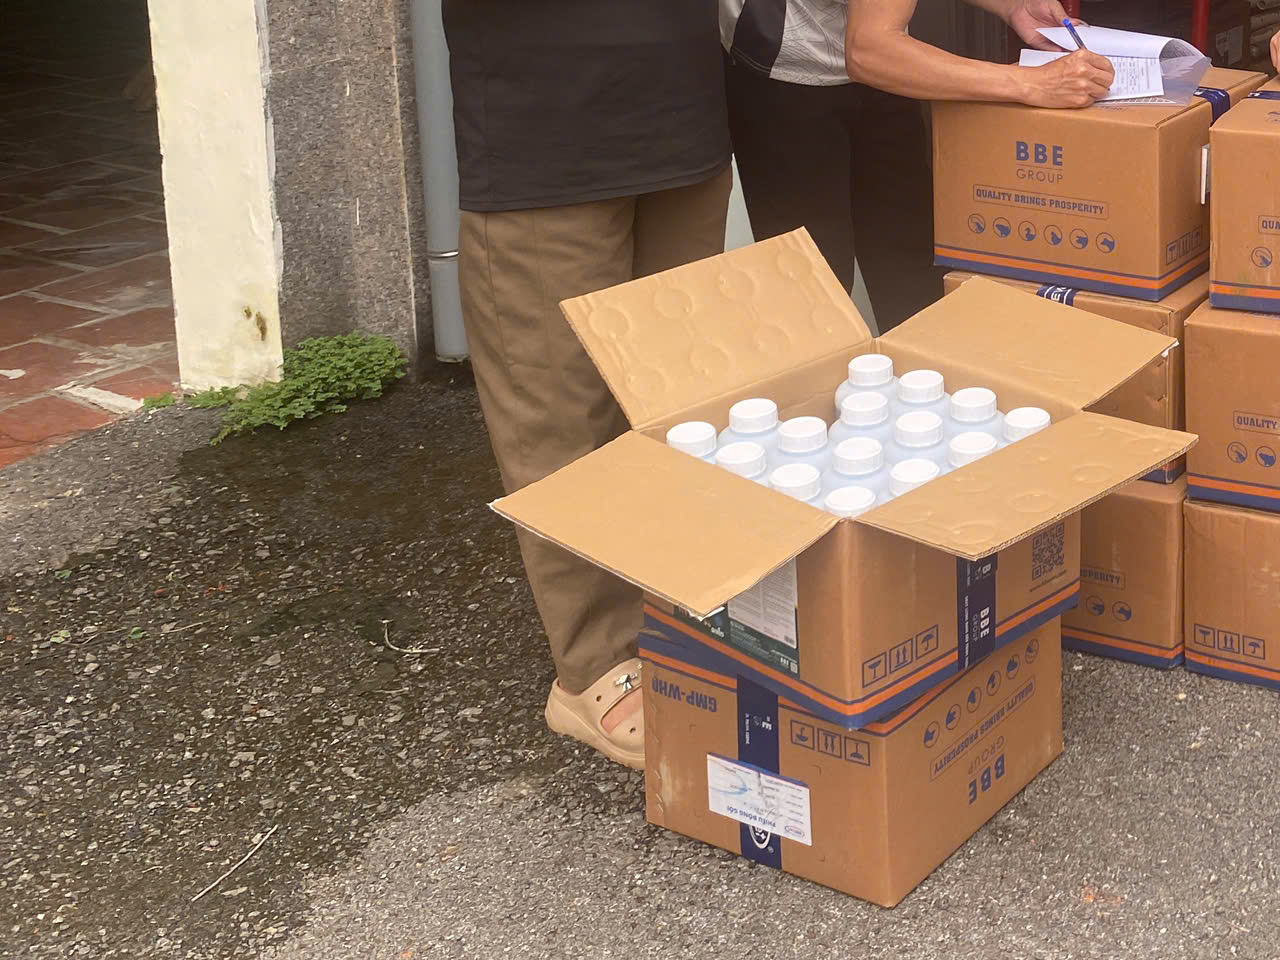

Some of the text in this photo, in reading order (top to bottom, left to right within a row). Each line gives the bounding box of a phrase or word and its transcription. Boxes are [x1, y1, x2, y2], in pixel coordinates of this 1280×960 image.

[1016, 141, 1063, 166] BBE
[1016, 168, 1063, 184] GROUP
[976, 188, 1104, 215] QUALITY BRINGS PROSPERITY
[1236, 415, 1277, 430] QUALITY
[981, 607, 990, 638] BBE
[934, 681, 1034, 774] QUALITY BRINGS PROSPERITY
[968, 736, 1005, 775] GROUP
[969, 754, 1005, 805] BBE
